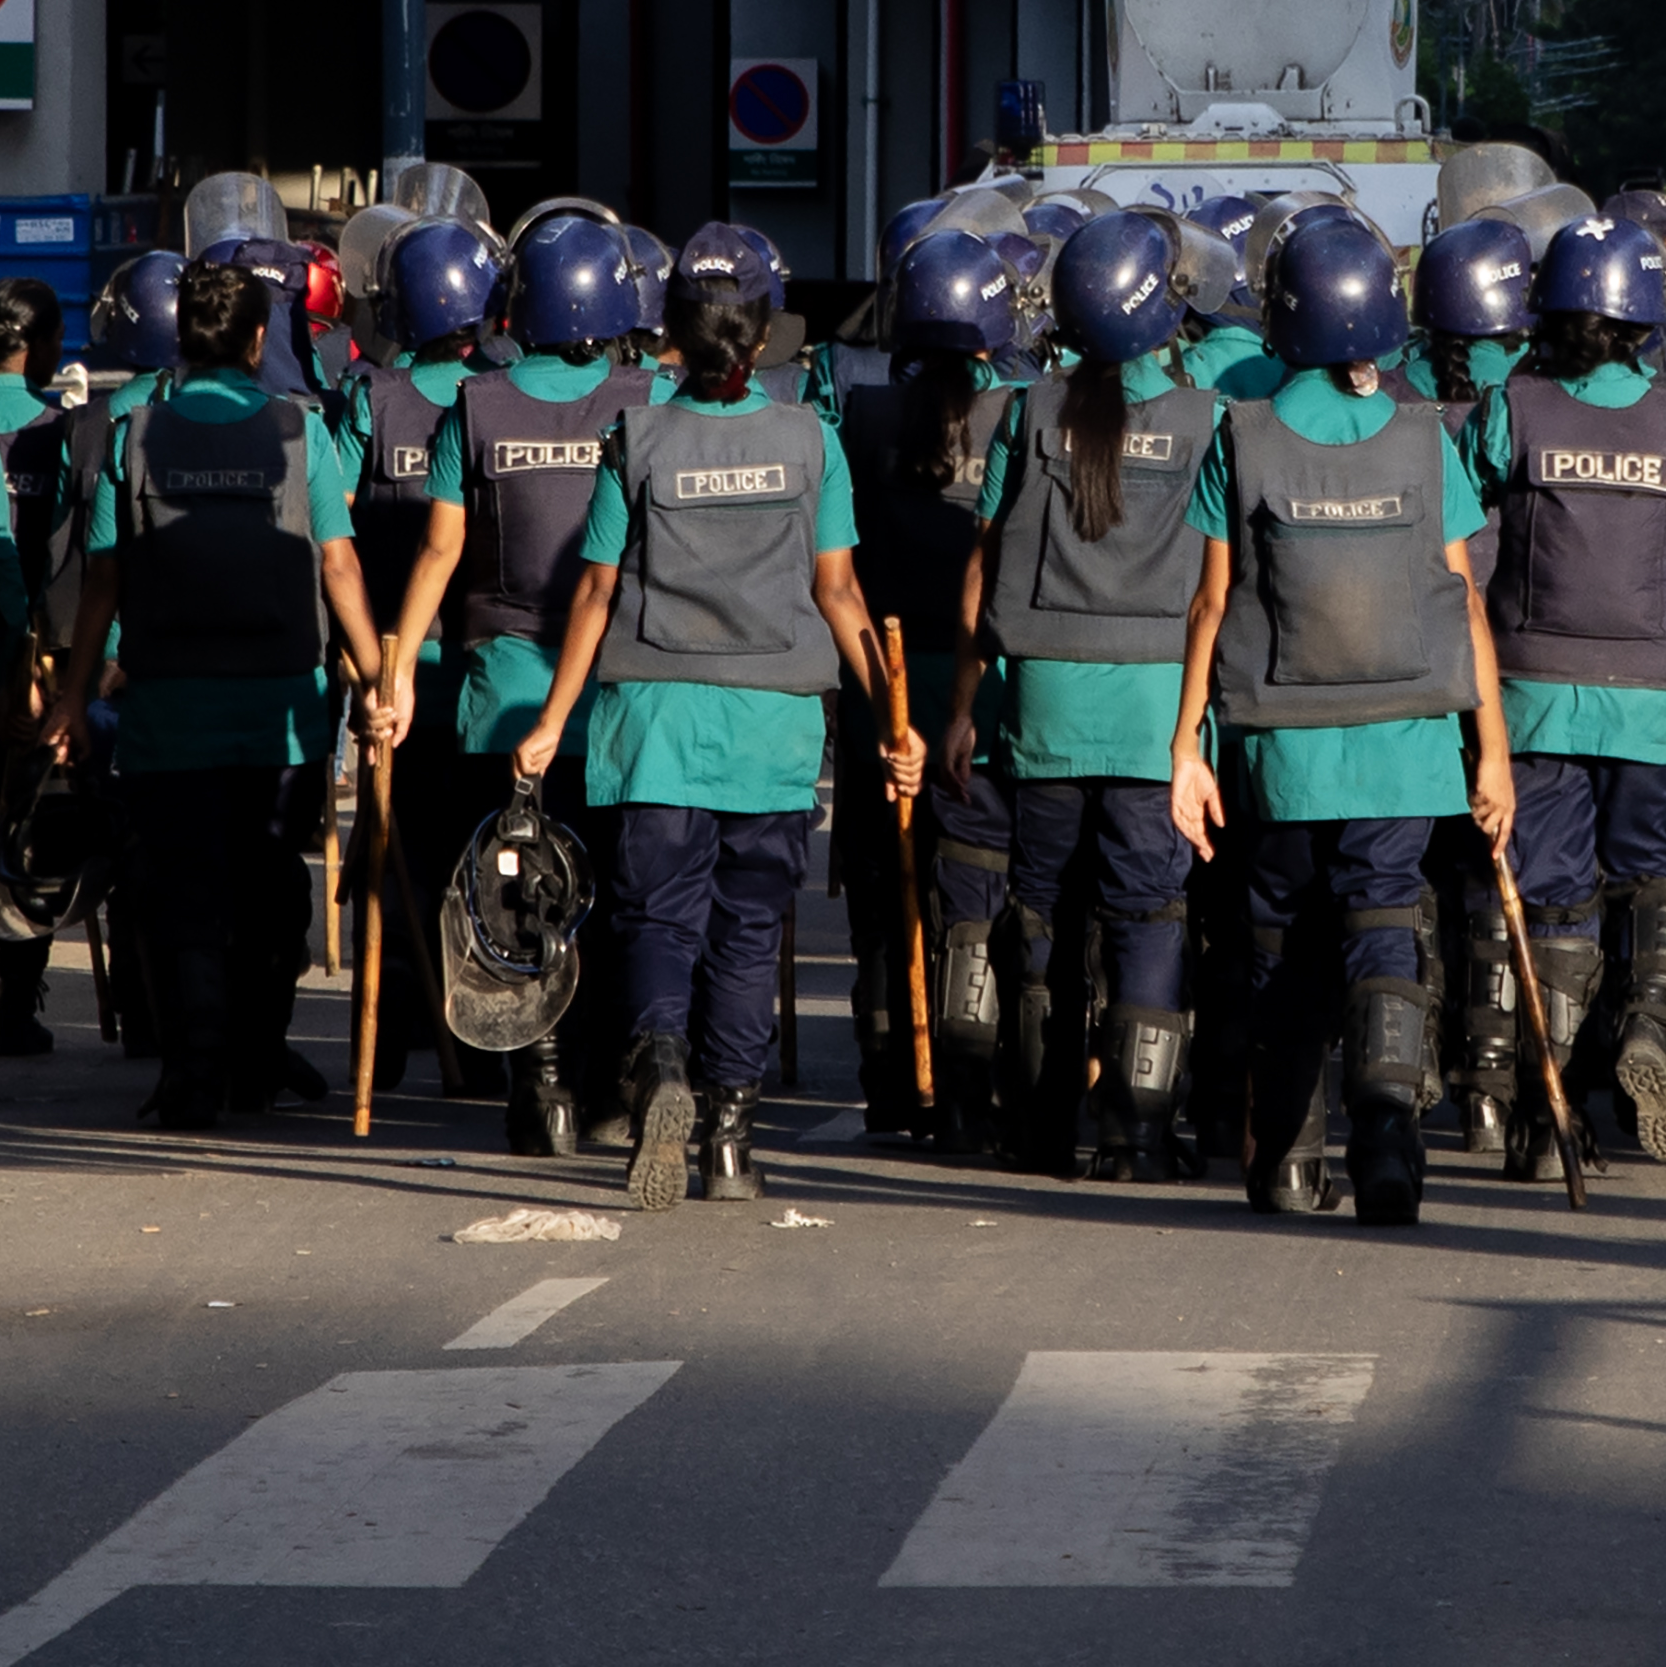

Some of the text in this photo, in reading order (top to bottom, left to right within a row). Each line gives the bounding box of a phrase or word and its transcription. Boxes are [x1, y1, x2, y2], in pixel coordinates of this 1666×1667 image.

[692, 257, 735, 274] POLICE
[1489, 262, 1522, 283] OLICE
[1121, 273, 1160, 316] POLICE
[182, 472, 248, 487] POLICE
[1554, 453, 1662, 485] POLICE
[695, 472, 767, 493] POLICE
[1310, 500, 1383, 518] POLICE
